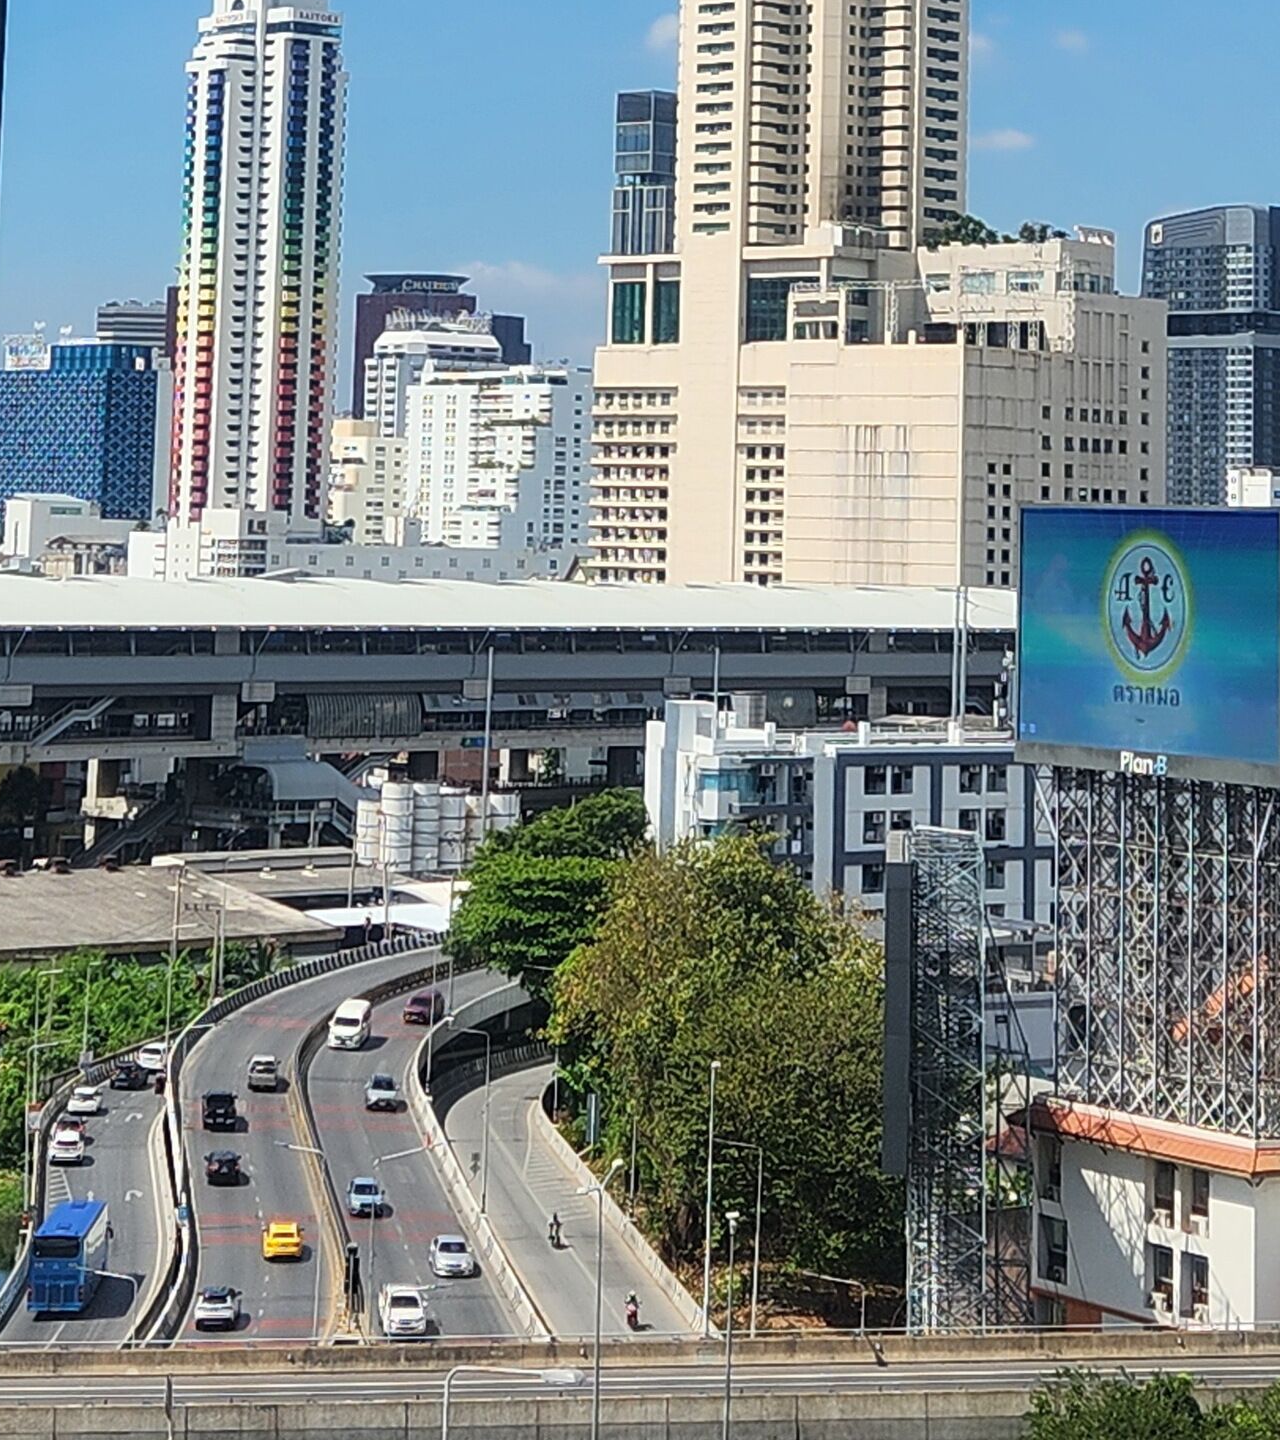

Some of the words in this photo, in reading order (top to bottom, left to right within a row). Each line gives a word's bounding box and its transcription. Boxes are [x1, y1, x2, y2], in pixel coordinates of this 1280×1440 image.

[1115, 573, 1134, 601] A
[1113, 684, 1180, 707] ตราสมอ
[1120, 751, 1153, 775] Plan
[1154, 755, 1168, 776] B
